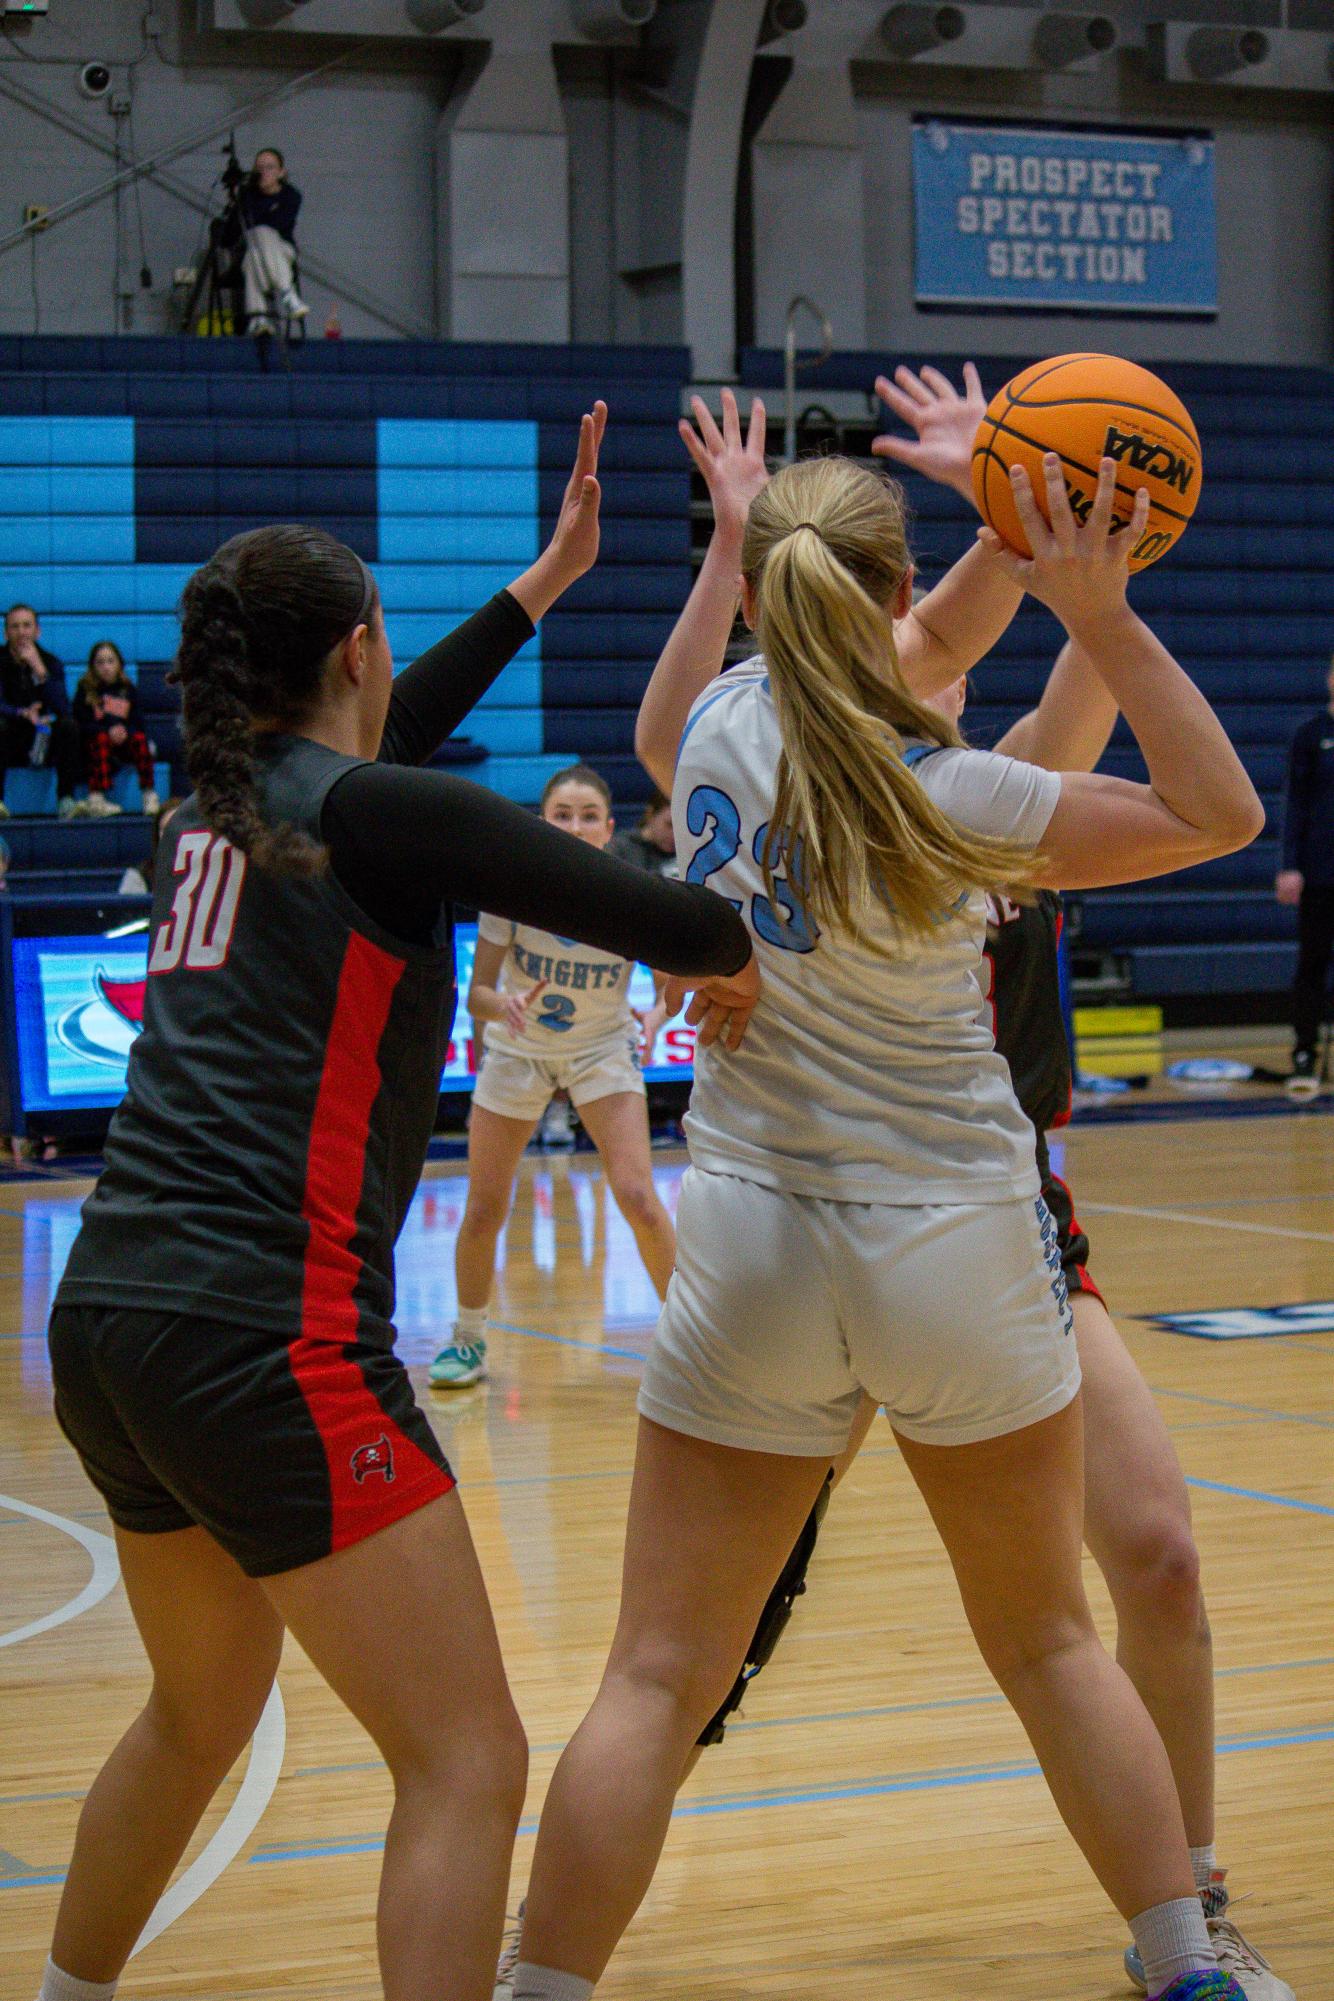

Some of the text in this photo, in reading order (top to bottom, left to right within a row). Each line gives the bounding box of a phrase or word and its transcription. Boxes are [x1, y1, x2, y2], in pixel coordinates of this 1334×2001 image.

[969, 153, 1161, 198] PROSPECT
[957, 197, 1173, 242] SPECTATOR
[987, 241, 1147, 283] SECTION
[1103, 425, 1194, 495] NCAA
[147, 828, 248, 976] 30
[514, 943, 622, 991] KNIGHTS
[537, 995, 576, 1033] 2
